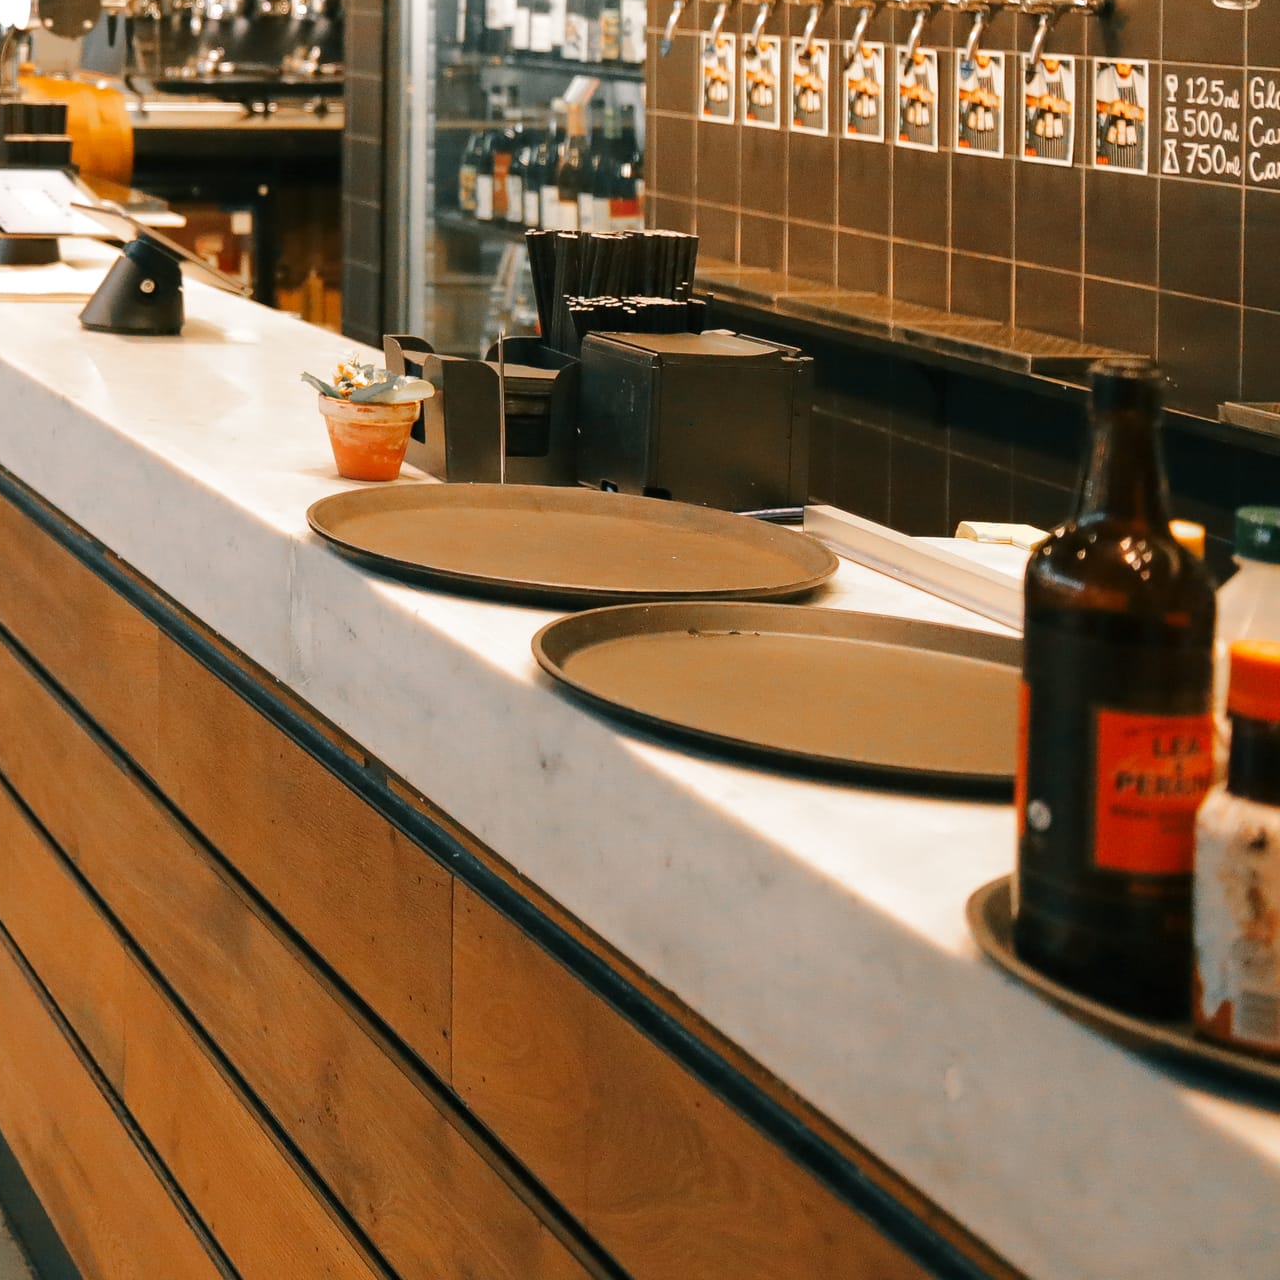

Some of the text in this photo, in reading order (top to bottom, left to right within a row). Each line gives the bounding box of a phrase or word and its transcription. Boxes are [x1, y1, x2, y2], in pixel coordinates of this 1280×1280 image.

[1185, 77, 1240, 109] 125ml
[1183, 109, 1239, 142] 500ml
[1181, 142, 1241, 177] 750ml
